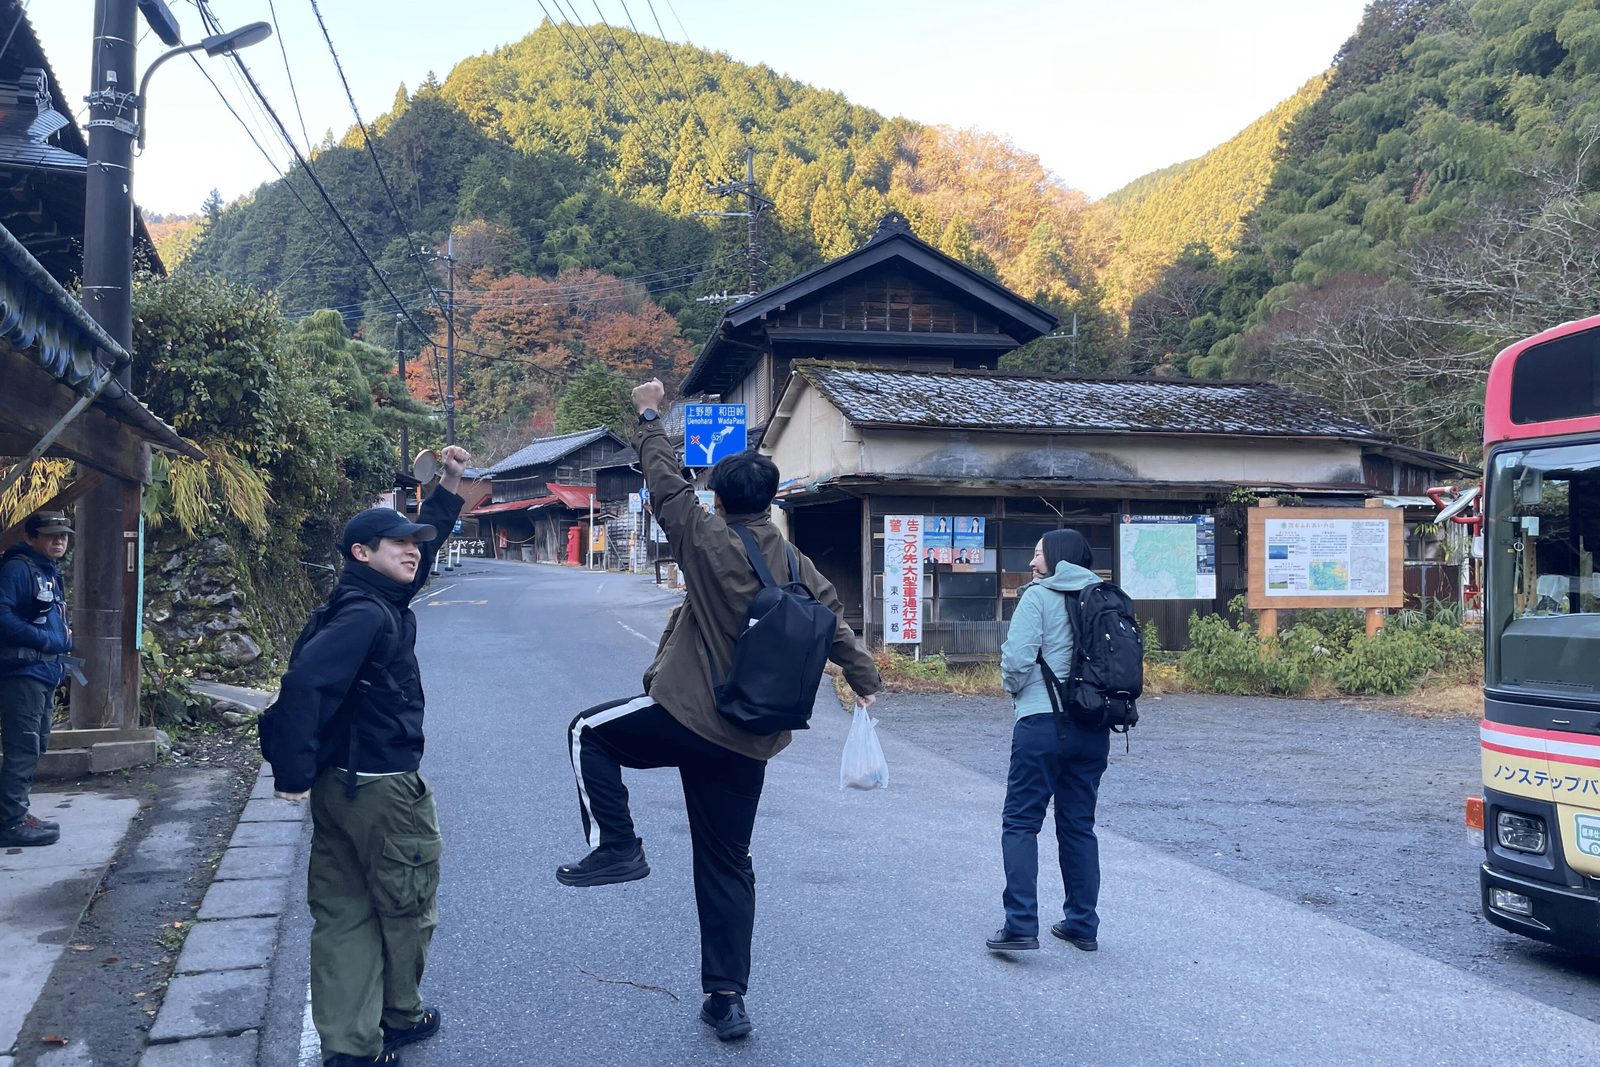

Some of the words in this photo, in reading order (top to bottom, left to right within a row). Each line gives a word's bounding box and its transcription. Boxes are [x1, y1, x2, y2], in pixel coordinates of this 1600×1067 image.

[890, 585, 900, 633] 東京都
[1493, 764, 1599, 795] ノンステップバ
